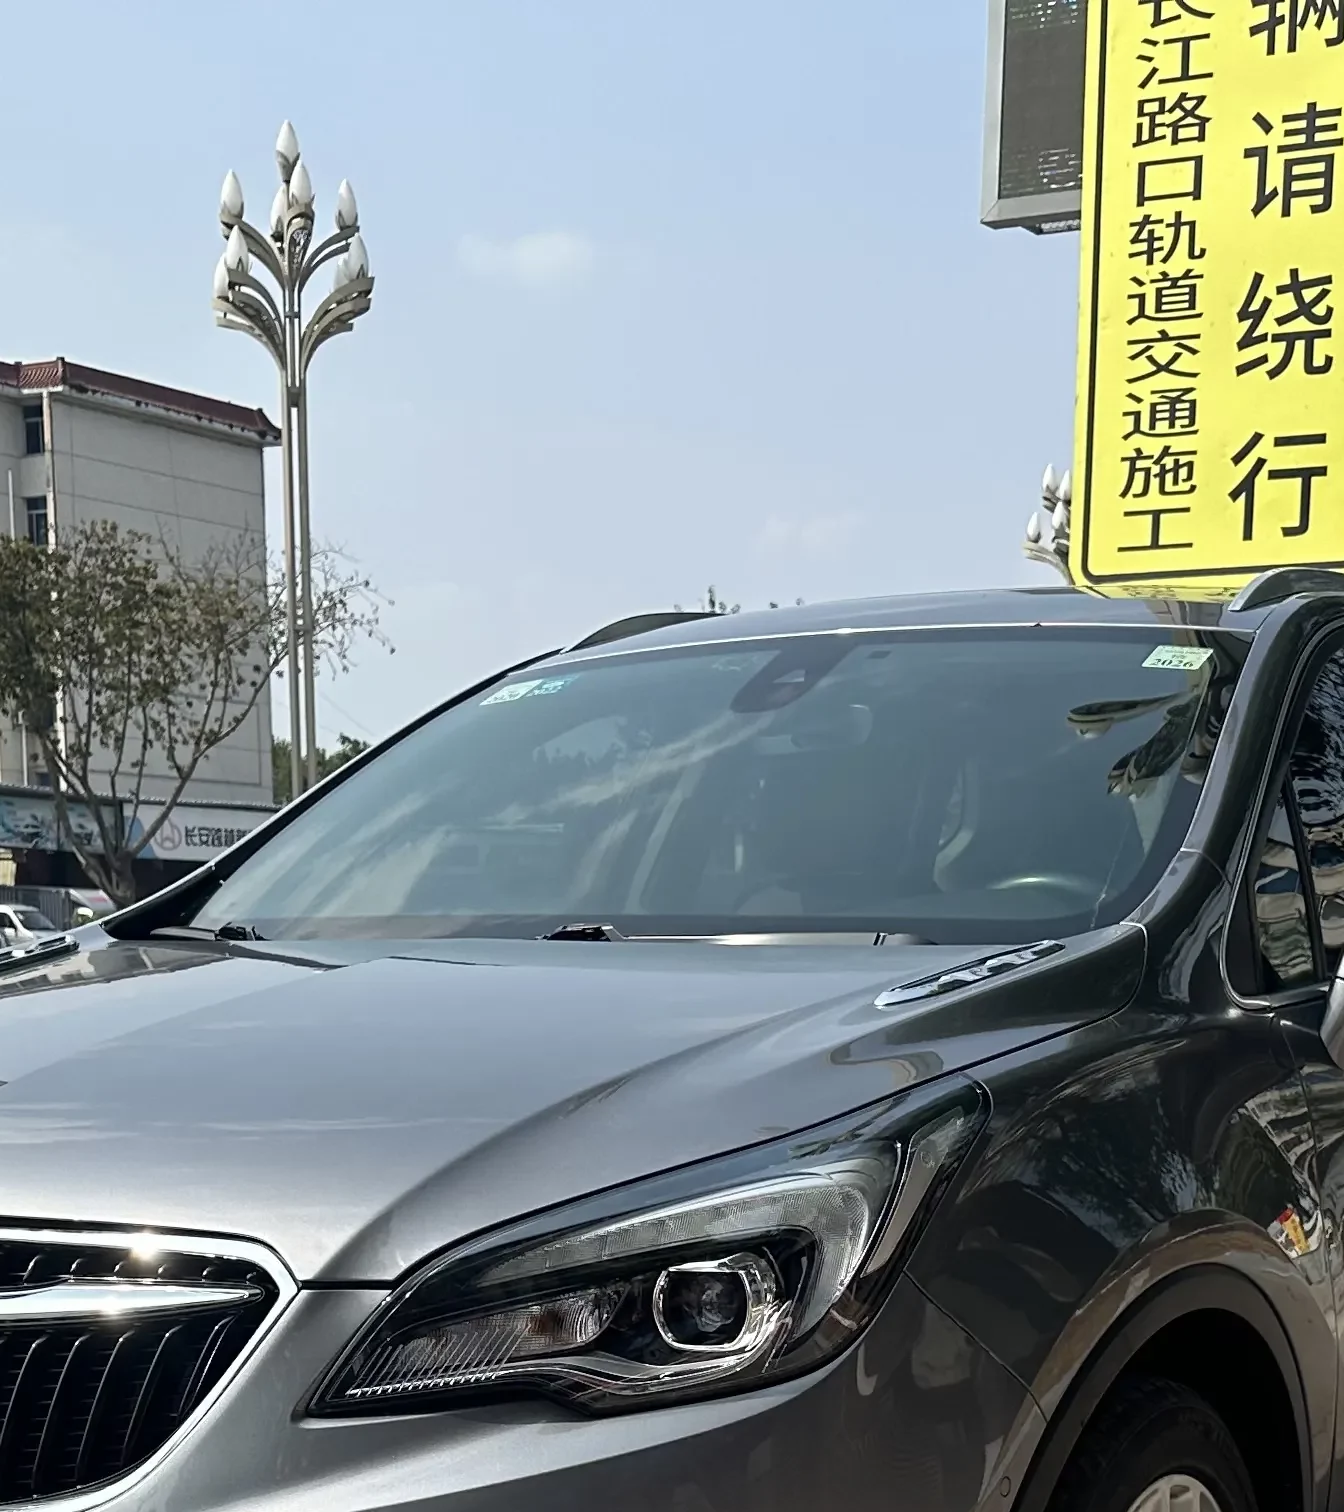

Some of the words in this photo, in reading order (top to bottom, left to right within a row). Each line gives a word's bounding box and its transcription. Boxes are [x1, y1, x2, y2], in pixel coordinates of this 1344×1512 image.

[1117, 0, 1214, 552] 长江路口轨道交通施工
